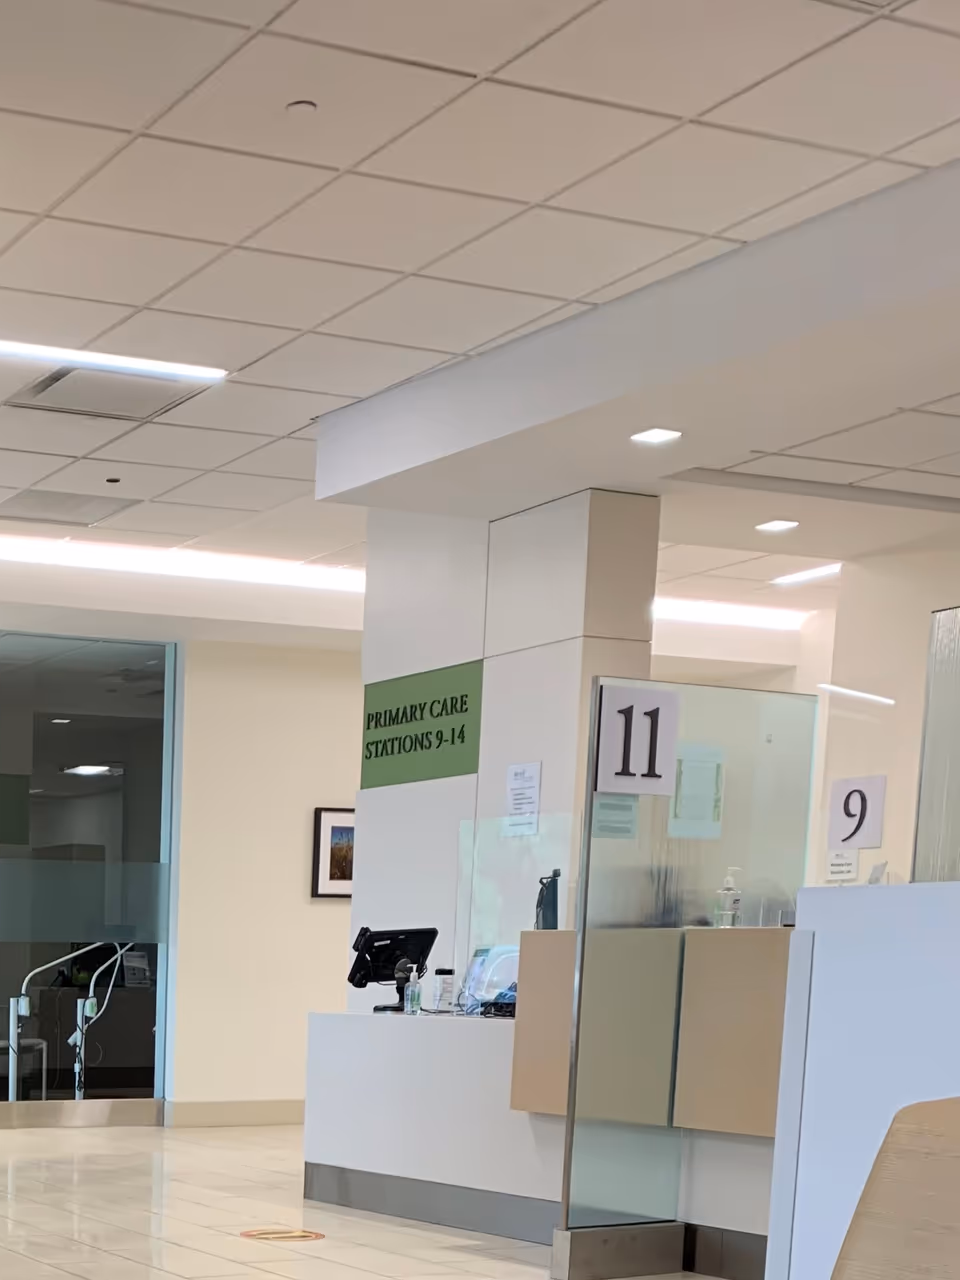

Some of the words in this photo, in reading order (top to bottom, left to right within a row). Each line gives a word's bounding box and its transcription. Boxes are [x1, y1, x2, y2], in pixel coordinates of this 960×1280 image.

[366, 702, 428, 730] PRIMARY
[429, 694, 468, 718] CARE
[364, 731, 432, 760] STATIONS
[435, 724, 465, 749] 9-14
[614, 704, 662, 778] 11
[841, 789, 867, 842] 9
